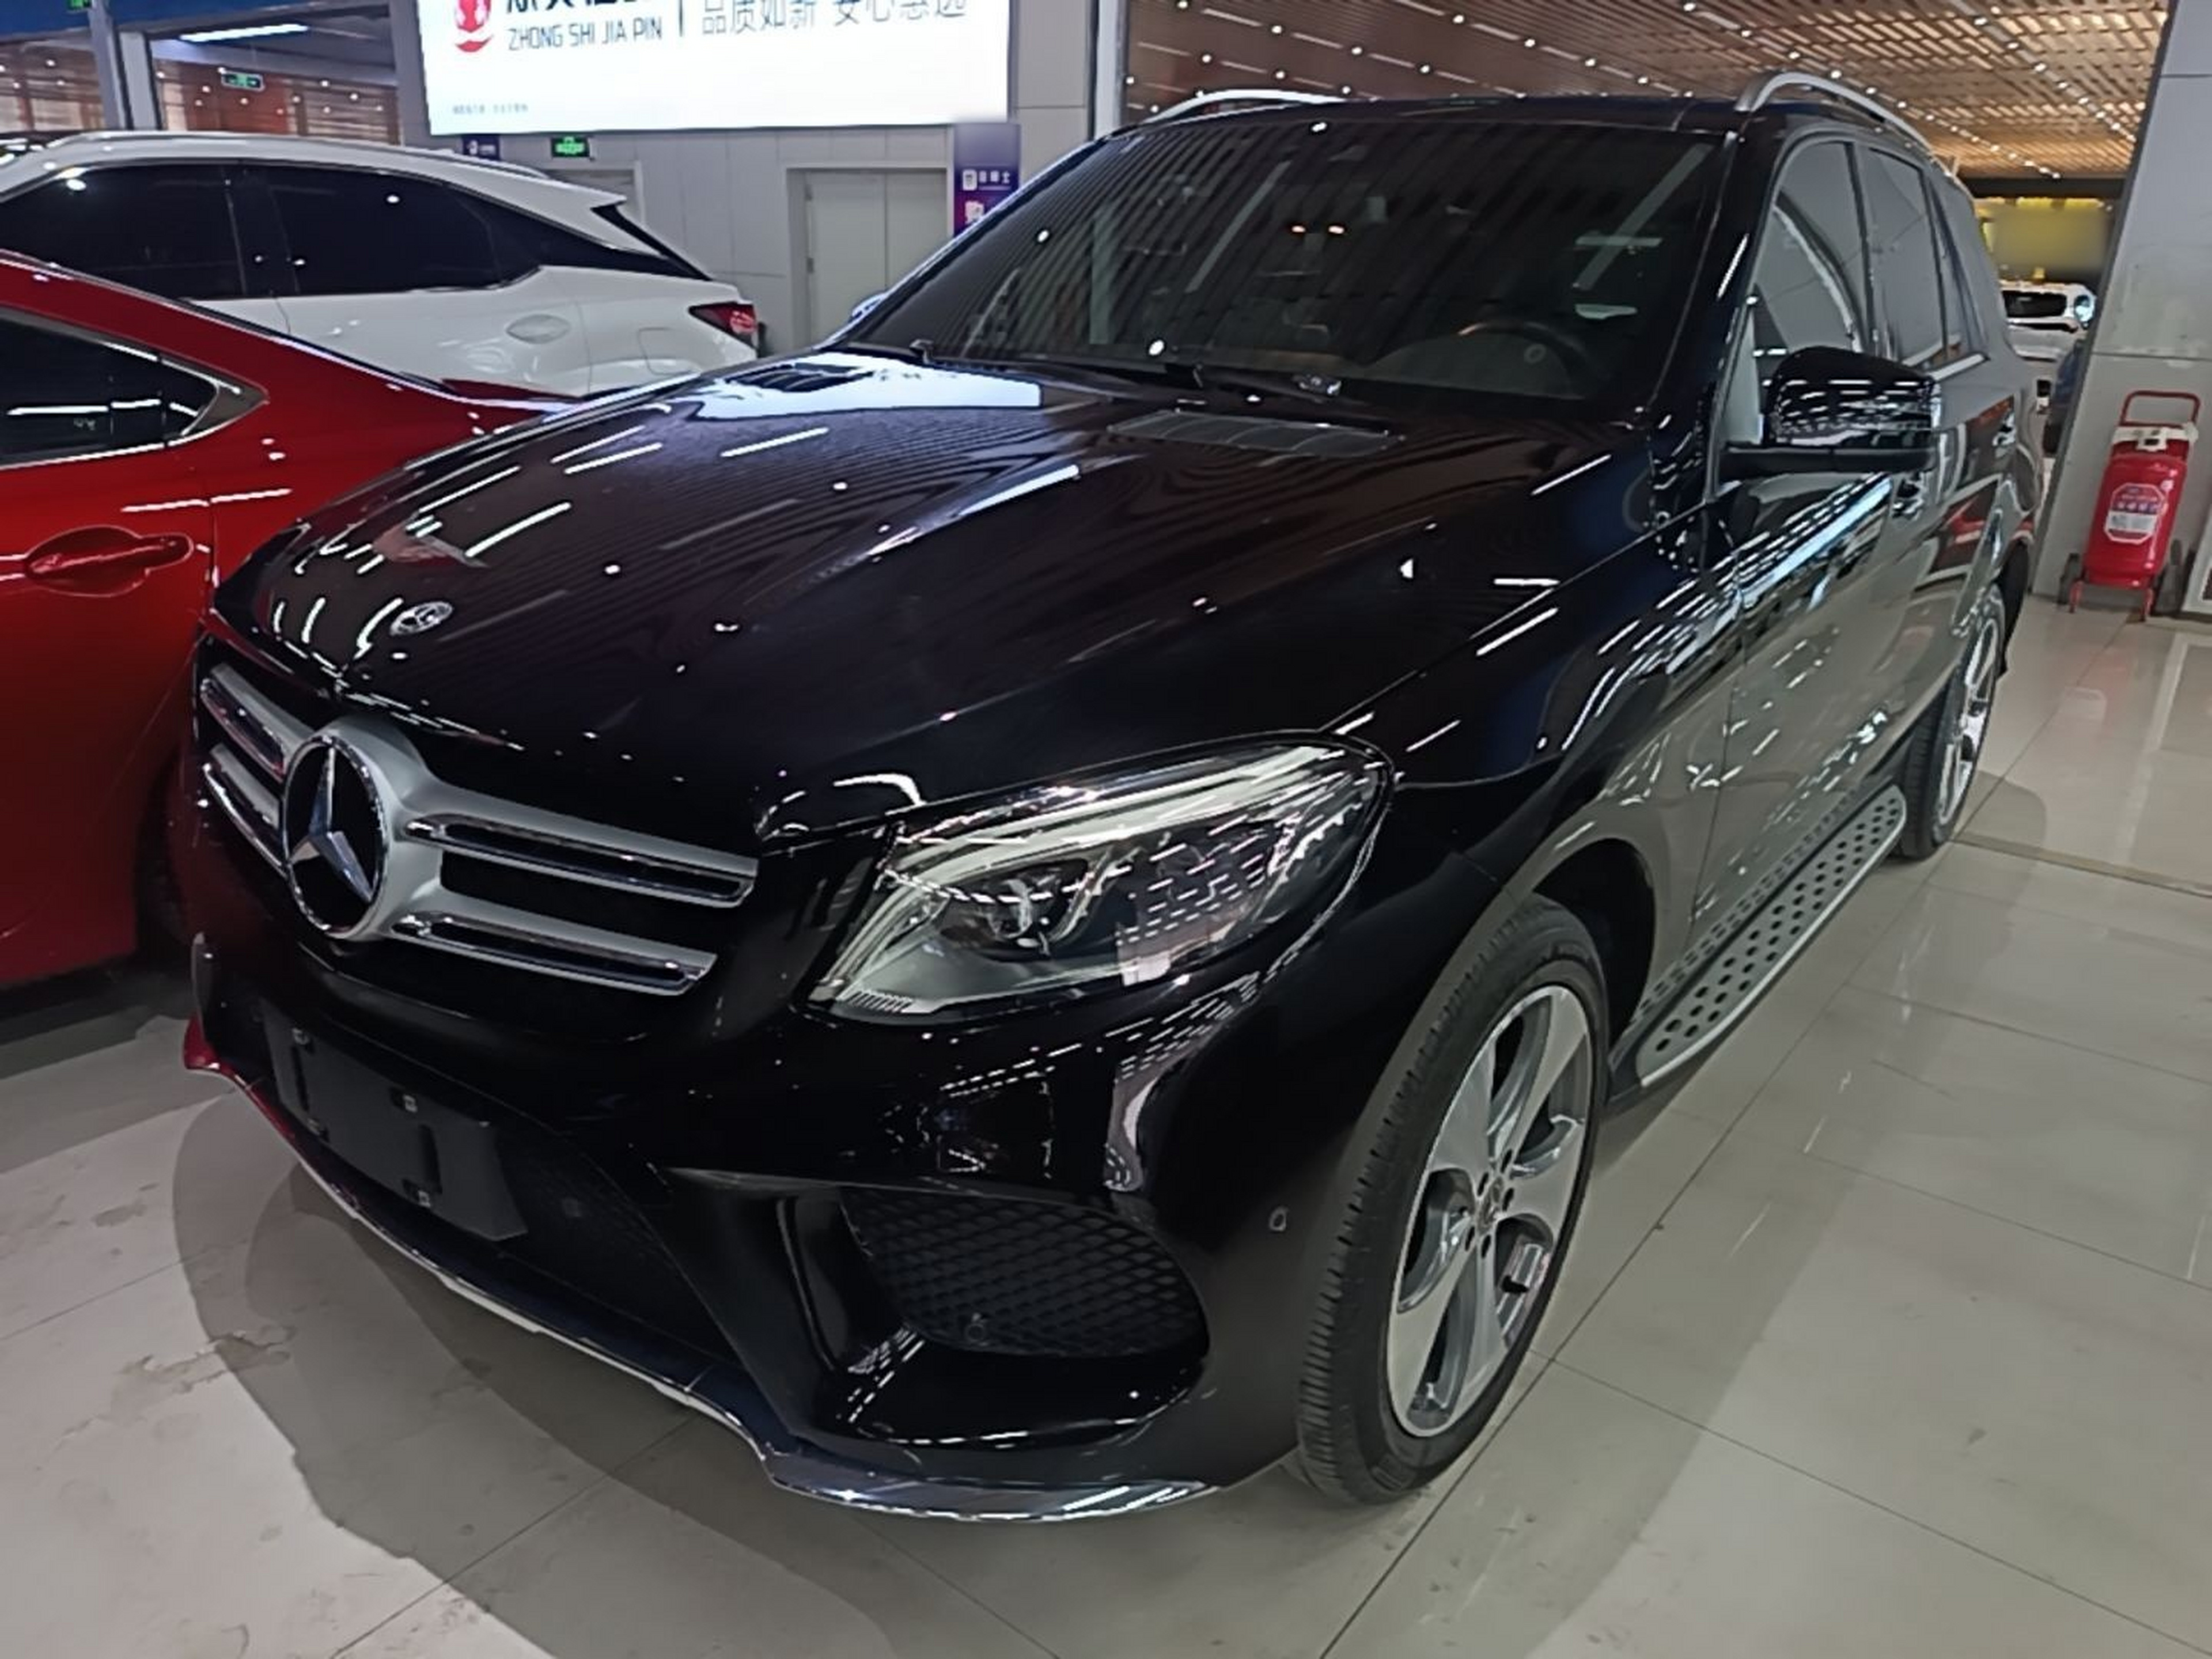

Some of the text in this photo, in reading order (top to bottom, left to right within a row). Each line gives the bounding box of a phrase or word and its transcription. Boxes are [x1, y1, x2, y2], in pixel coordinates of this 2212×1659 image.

[505, 16, 663, 51] ZHONG SHI JIA PIN
[702, 0, 816, 35] 品质如新
